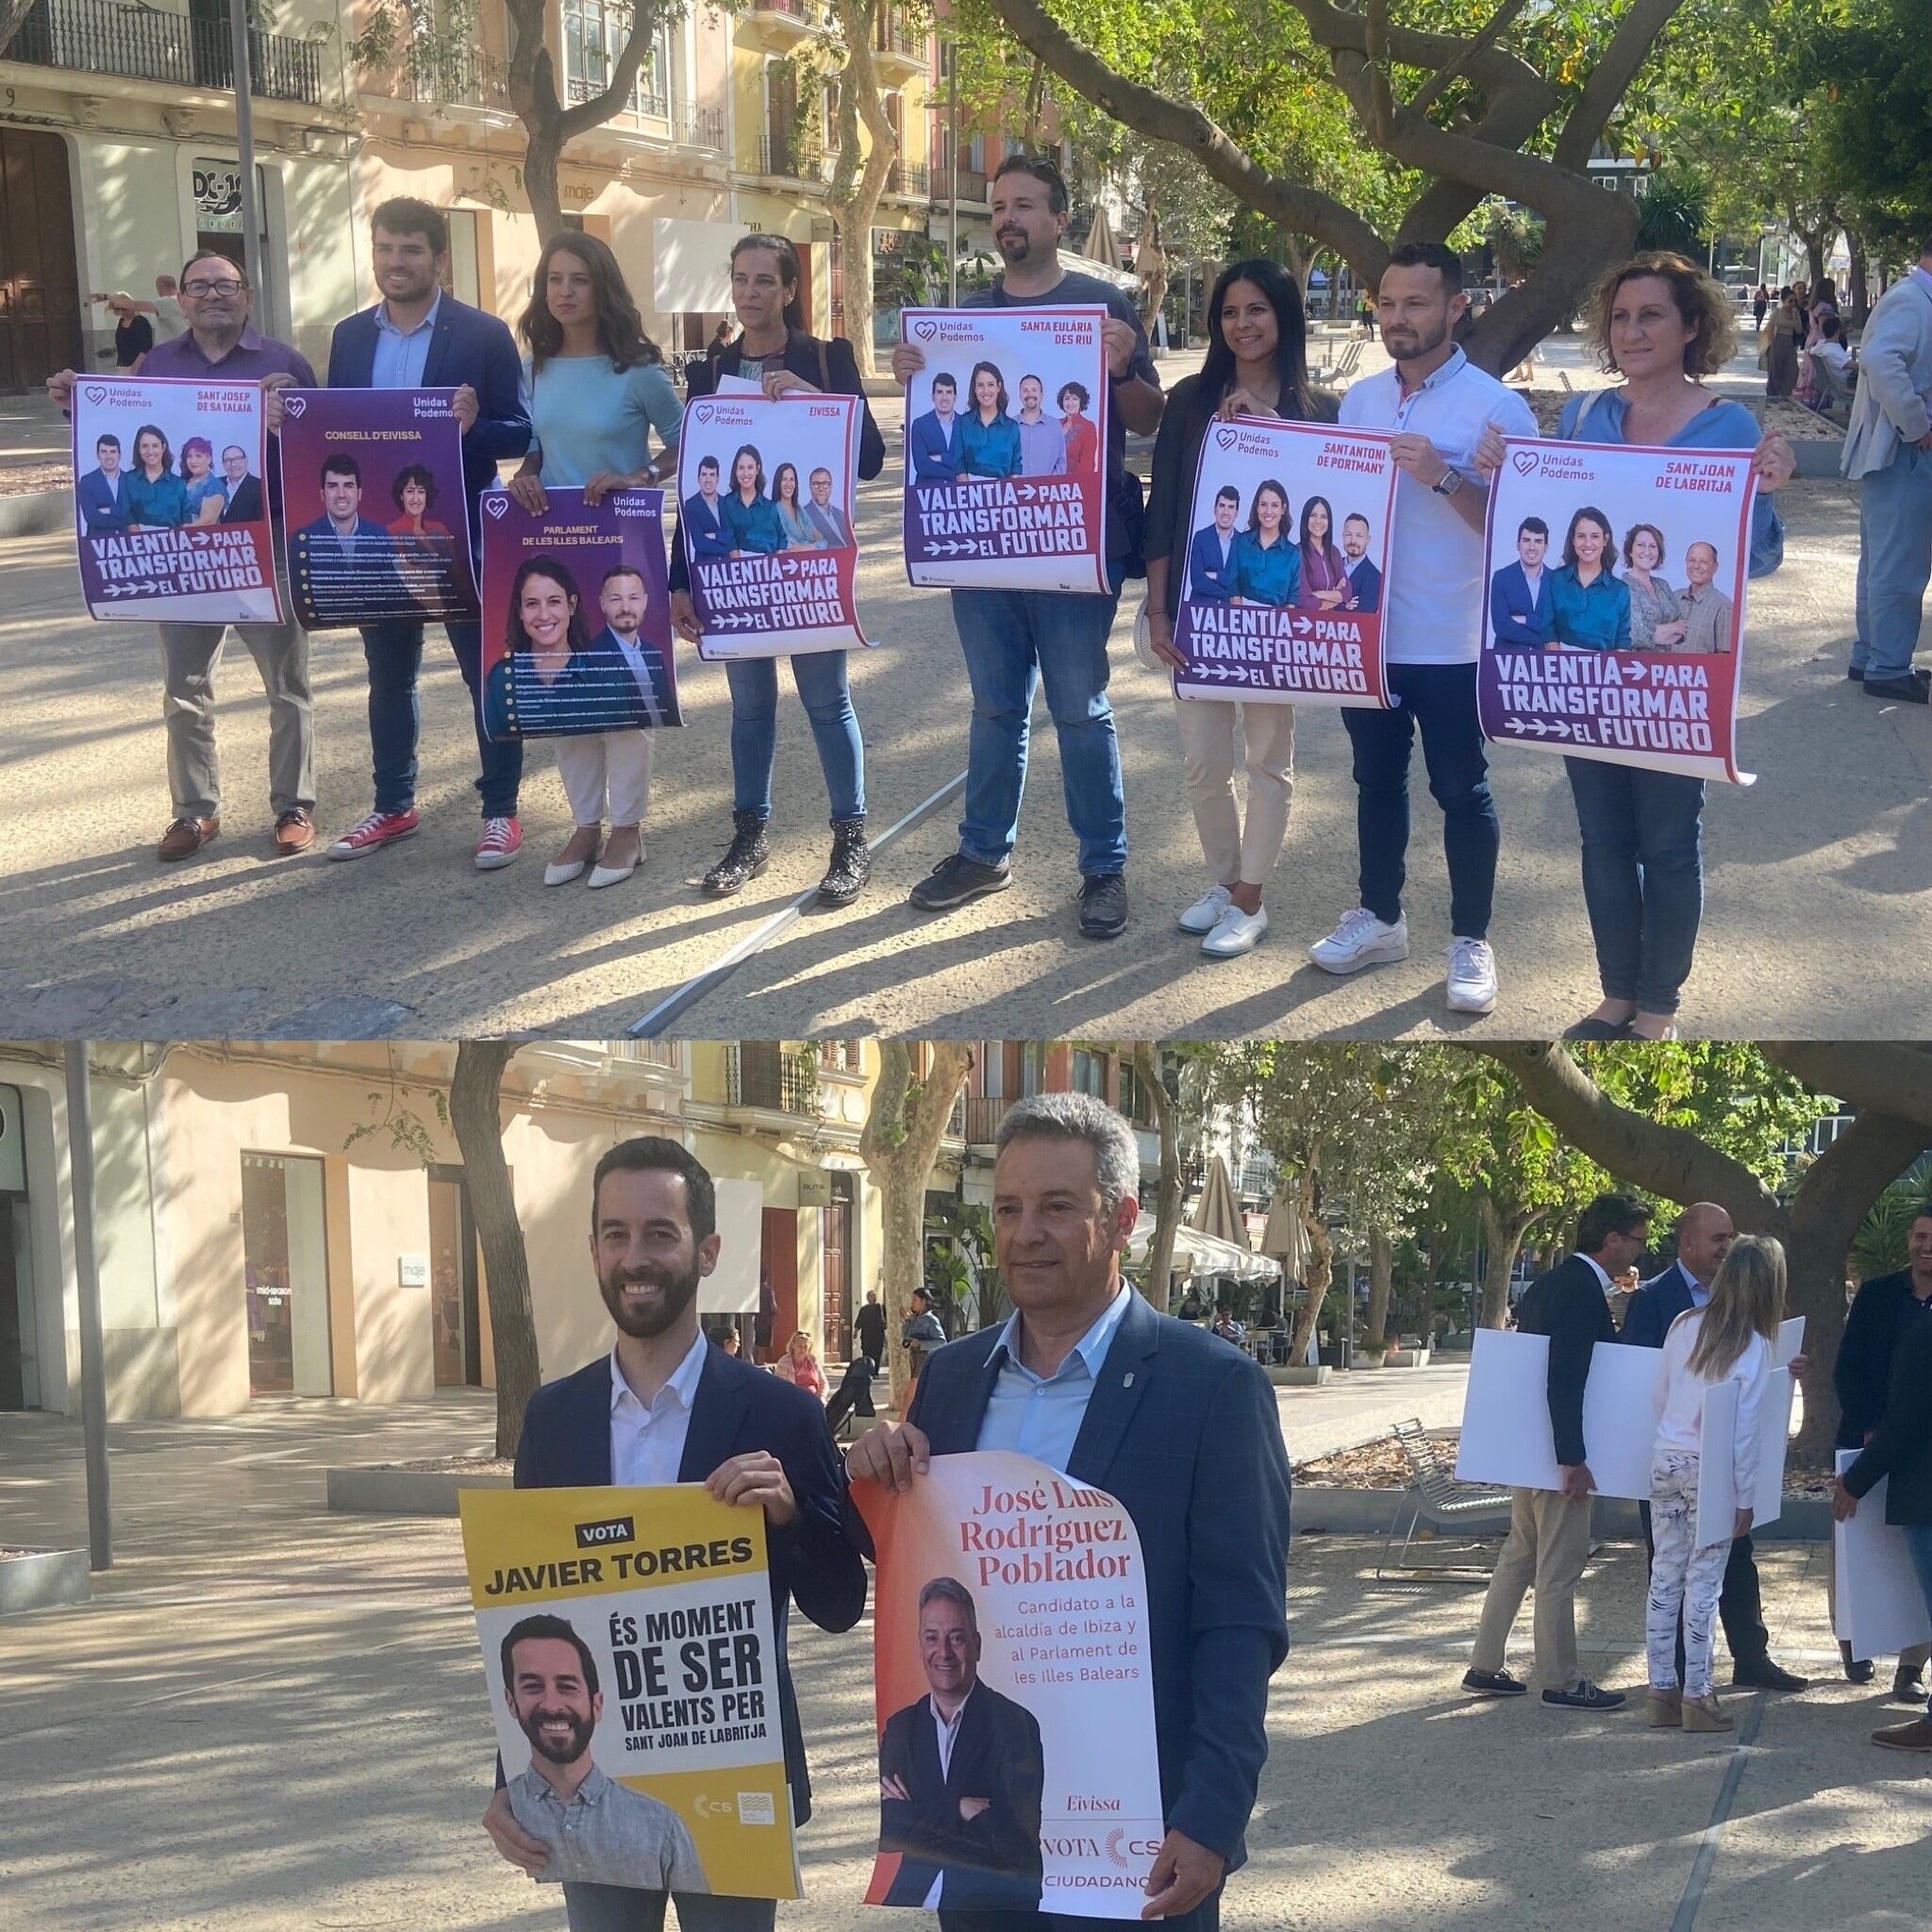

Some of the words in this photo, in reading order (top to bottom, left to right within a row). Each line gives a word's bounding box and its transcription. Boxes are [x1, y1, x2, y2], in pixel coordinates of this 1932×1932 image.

[6, 88, 15, 107] 9
[565, 183, 594, 202] maje
[940, 322, 973, 331] Unidas
[1021, 322, 1051, 331] SANTA
[941, 333, 984, 341] Podemos
[1055, 335, 1074, 344] DES
[1076, 335, 1092, 345] RIU
[109, 388, 142, 398] Unidas
[198, 391, 220, 400] SANT
[221, 392, 250, 401] JOSEP
[413, 397, 447, 407] Unidas
[109, 398, 152, 408] Podemos
[197, 403, 209, 412] DE
[210, 404, 222, 412] SA
[223, 404, 252, 413] TALAIA
[716, 406, 744, 415] Unidas
[809, 408, 840, 416] EIVISSA
[414, 408, 454, 417] Podemo
[715, 416, 753, 425] Podemos
[325, 431, 371, 440] CONSELL
[373, 431, 422, 440] D'EIVISSA
[1240, 432, 1271, 445] Unidas
[1238, 444, 1279, 458] Podemos
[1324, 442, 1349, 457] SANT
[1349, 446, 1385, 460] ANTONI
[1317, 456, 1330, 467] DE
[1331, 458, 1384, 474] PORTMANY
[1543, 454, 1583, 467] Unidas
[1541, 467, 1595, 481] Podemos
[1666, 463, 1699, 475] SANT
[1700, 465, 1735, 477] JOAN
[1656, 476, 1672, 488] DE
[1674, 478, 1732, 493] LABRITJA
[614, 497, 645, 506] Unidas
[916, 481, 1018, 511] VALENTÍA
[1039, 483, 1083, 502] PARA
[615, 508, 656, 517] Podemos
[920, 503, 1084, 536] TRANSFORMAR
[544, 525, 598, 534] PARLAMENT
[92, 530, 192, 558] VALENTÍA
[213, 530, 254, 548] PARA
[523, 538, 535, 546] DE
[536, 537, 552, 545] LES
[554, 537, 578, 545] ILLES
[579, 536, 623, 544] BALEARS
[979, 540, 996, 556] EL
[1000, 527, 1087, 555] FUTURO
[97, 546, 258, 580] TRANSFORMAR
[698, 556, 784, 587] VALENTÍA
[800, 558, 838, 576] PARA
[158, 581, 177, 595] EL
[179, 566, 263, 593] FUTURO
[703, 577, 838, 610] TRANSFORMAR
[755, 613, 770, 629] EL
[771, 602, 845, 626] FUTURO
[1190, 606, 1292, 637] VALENTÍA
[1316, 622, 1361, 641] PARA
[1190, 633, 1363, 668] TRANSFORMAR
[1250, 669, 1269, 686] EL
[1272, 665, 1367, 692] FUTURO
[1495, 653, 1623, 685] VALENTÍA
[1651, 665, 1709, 687] PARA
[1498, 684, 1709, 720] TRANSFORMAR
[1573, 723, 1596, 743] EL
[1599, 718, 1712, 752] FUTURO
[404, 1265, 425, 1278] maje
[972, 1480, 1048, 1516] José
[1050, 1480, 1113, 1511] Luis
[583, 1524, 628, 1542] VOTA
[960, 1515, 1127, 1553] Rodríguez
[485, 1558, 603, 1595] JAVIER
[611, 1537, 753, 1579] TORRES
[978, 1549, 1131, 1587] Poblador
[1018, 1597, 1099, 1615] Candidato
[1105, 1599, 1115, 1609] a
[1120, 1595, 1135, 1608] la
[608, 1611, 638, 1646] ÉS
[645, 1600, 755, 1642] MOMENT
[1058, 1620, 1078, 1636] de
[1083, 1618, 1122, 1634] Ibiza
[1127, 1622, 1136, 1635] y
[1011, 1646, 1024, 1661] al
[1030, 1643, 1113, 1660] Parlament
[1118, 1641, 1138, 1656] de
[613, 1646, 668, 1699] DE
[680, 1633, 762, 1691] SER
[1014, 1669, 1036, 1684] les
[1041, 1667, 1075, 1683] Illes
[1080, 1666, 1139, 1682] Balears
[621, 1697, 715, 1732] VALENTS
[723, 1690, 765, 1721] PER
[625, 1735, 654, 1752] SANT
[658, 1732, 688, 1749] JOAN
[692, 1730, 707, 1745] DE
[710, 1723, 766, 1743] LABRITJA
[1066, 1795, 1121, 1812] Eivissa
[1043, 1838, 1100, 1857] VOTA
[1129, 1841, 1161, 1855] CS
[1044, 1875, 1150, 1888] CIUDADANO
